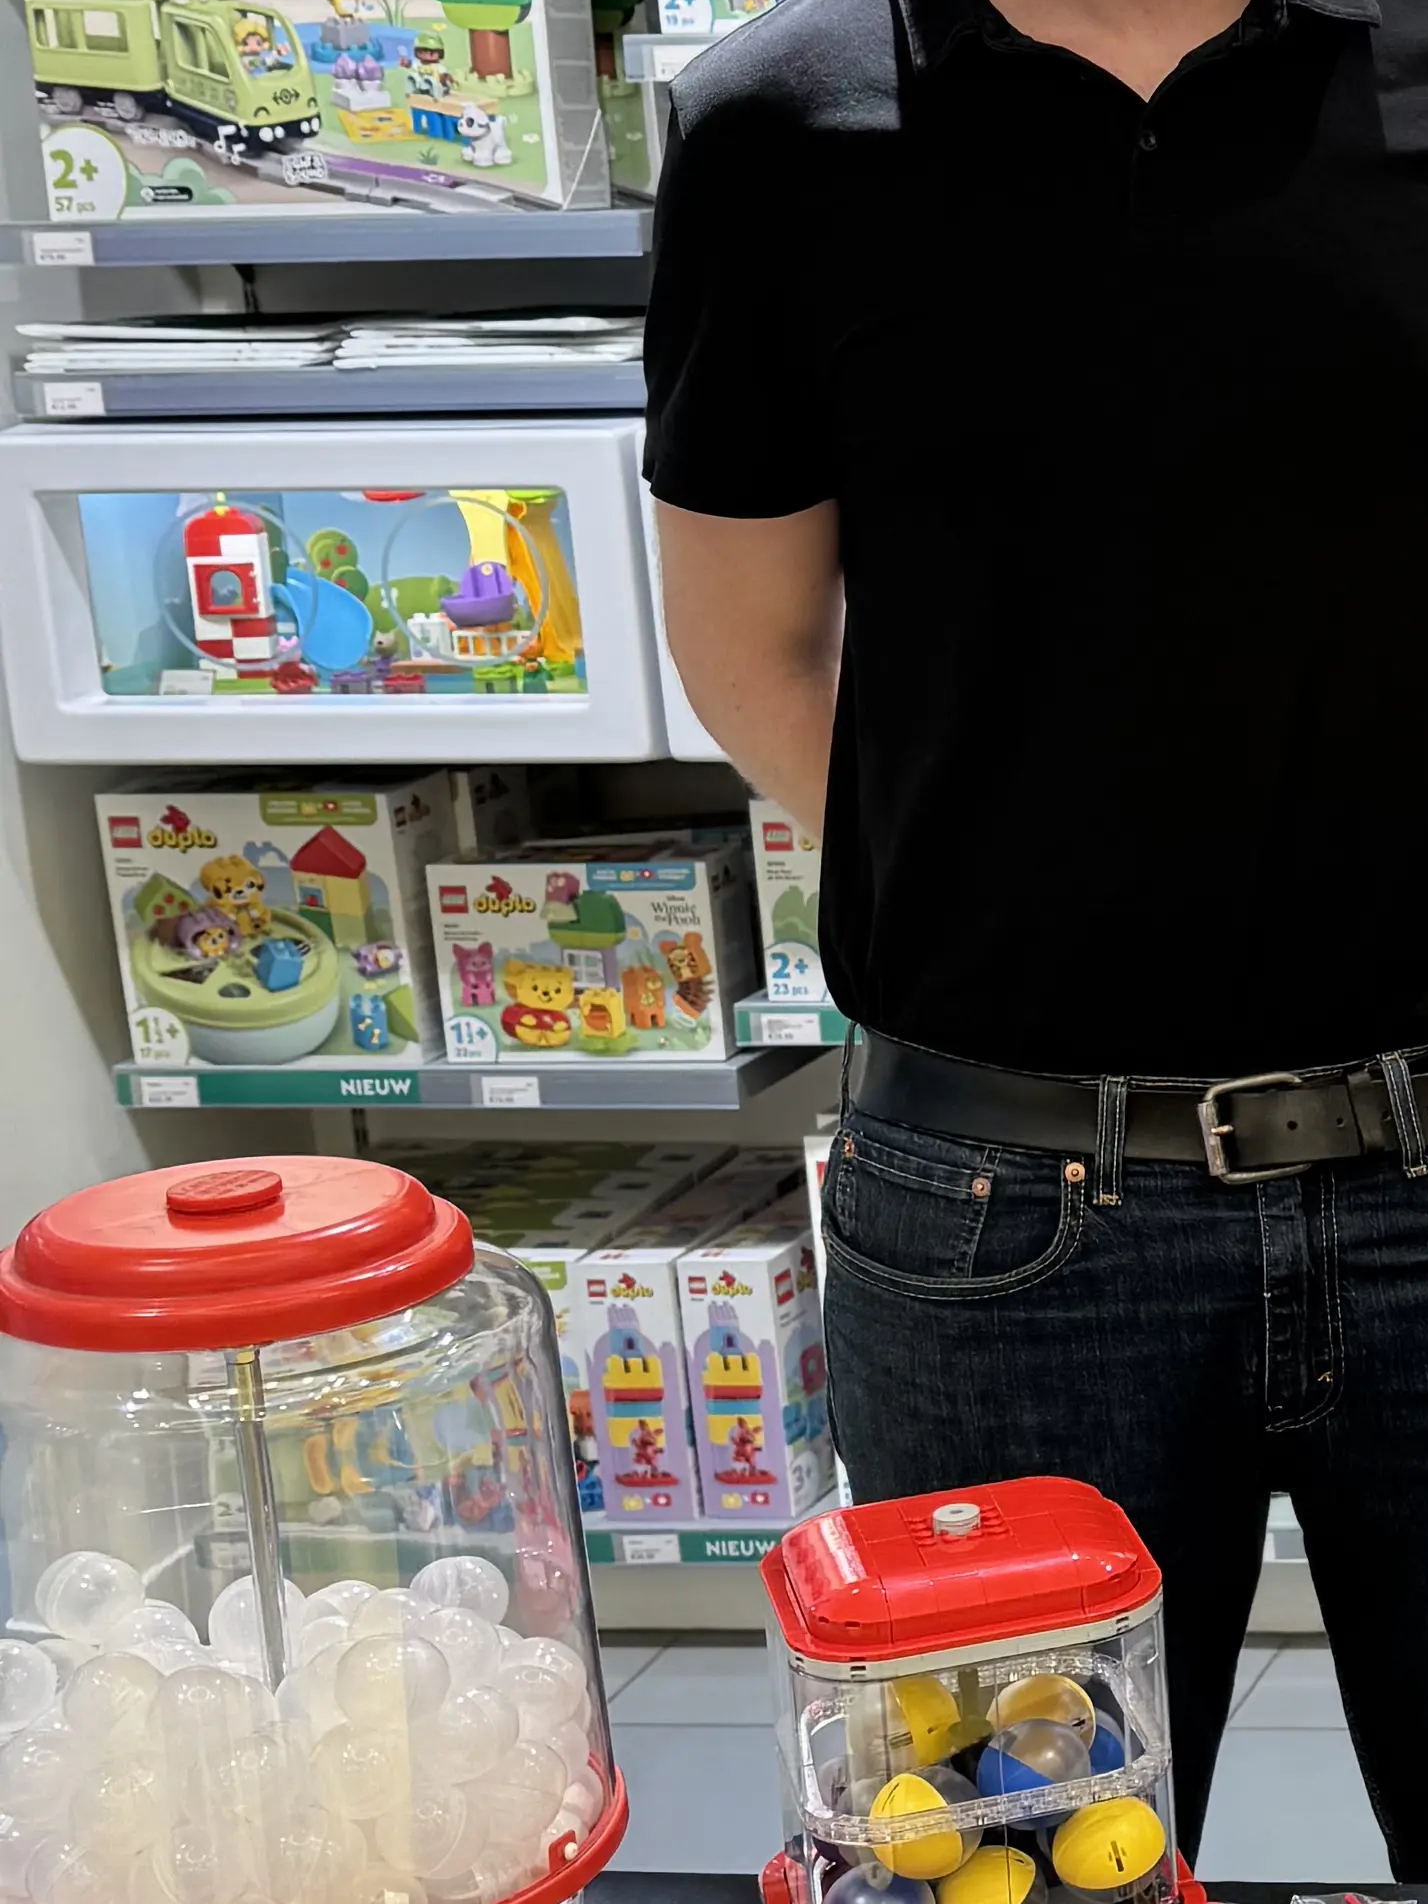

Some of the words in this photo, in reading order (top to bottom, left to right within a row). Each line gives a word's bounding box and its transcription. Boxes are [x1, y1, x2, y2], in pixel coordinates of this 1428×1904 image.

[49, 149, 99, 190] 2+
[771, 952, 809, 979] 2+
[339, 1078, 412, 1096] NIEUW
[705, 1538, 775, 1558] NIEUW
